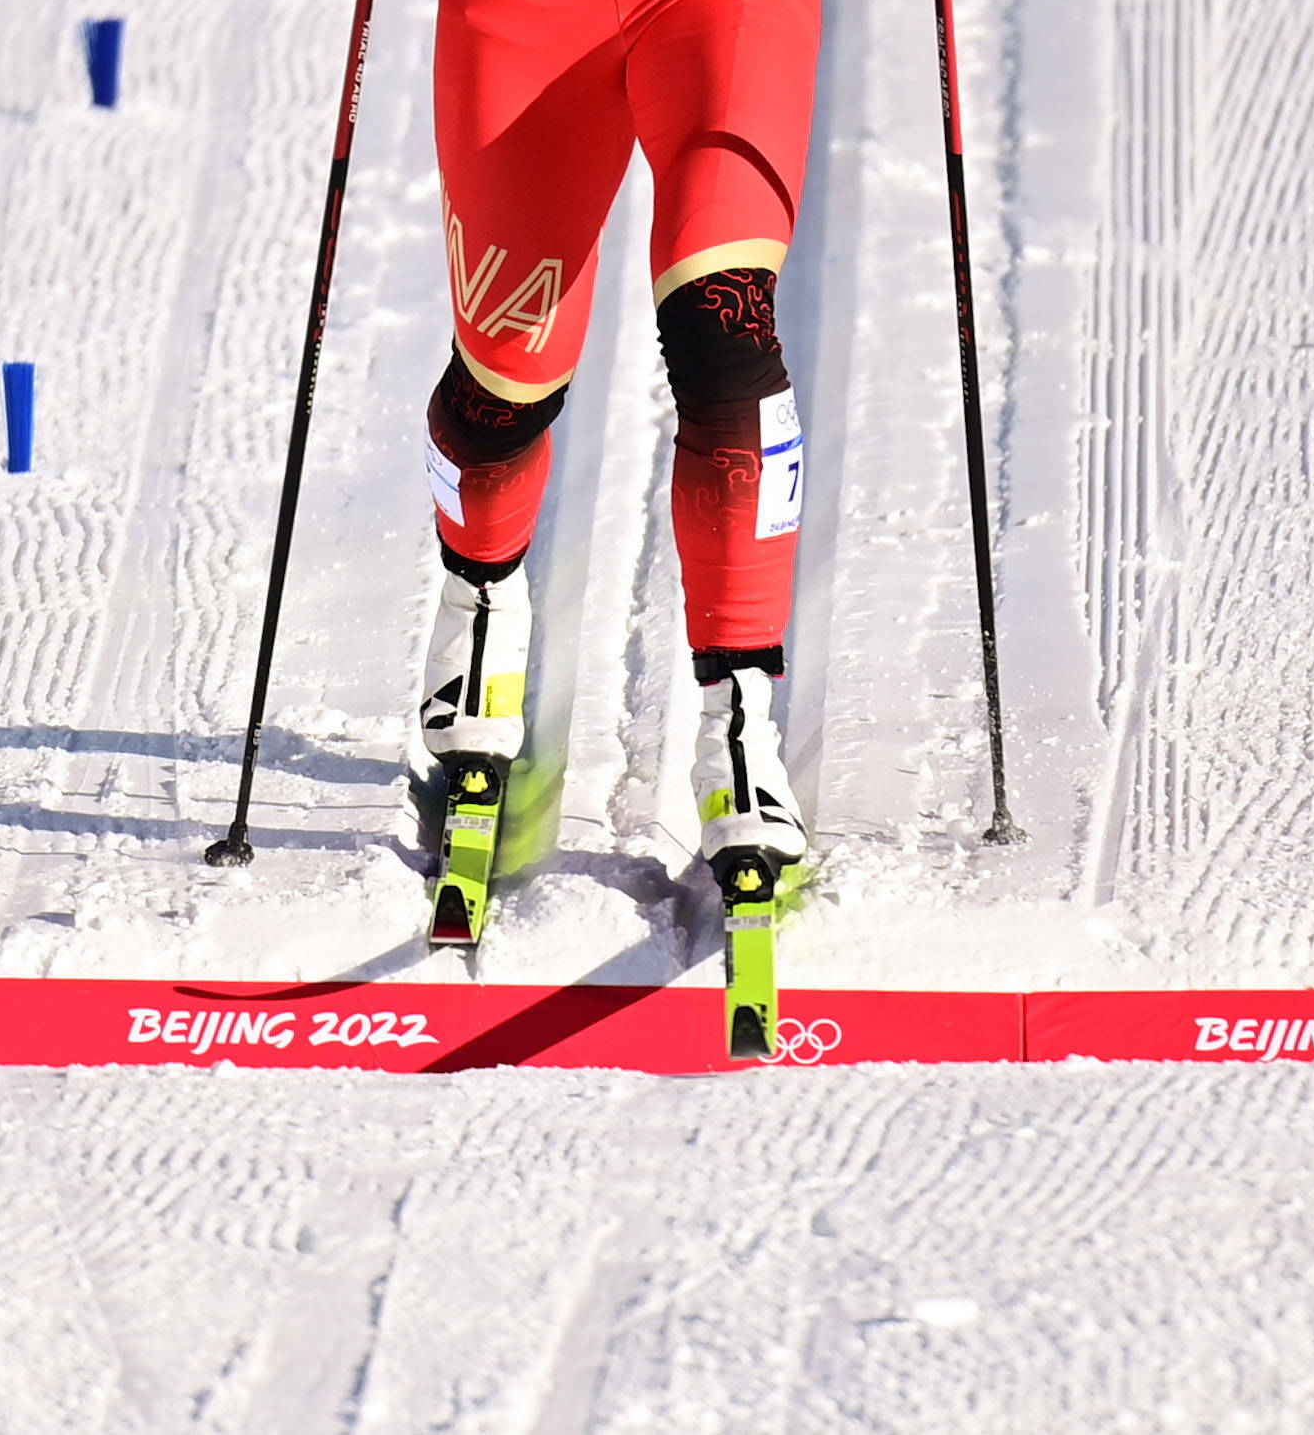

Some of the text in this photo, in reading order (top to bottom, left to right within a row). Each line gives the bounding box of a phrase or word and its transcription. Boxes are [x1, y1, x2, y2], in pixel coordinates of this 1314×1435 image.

[442, 186, 564, 354] NA
[788, 460, 800, 503] 7
[127, 1008, 441, 1056] BEIJING 2022
